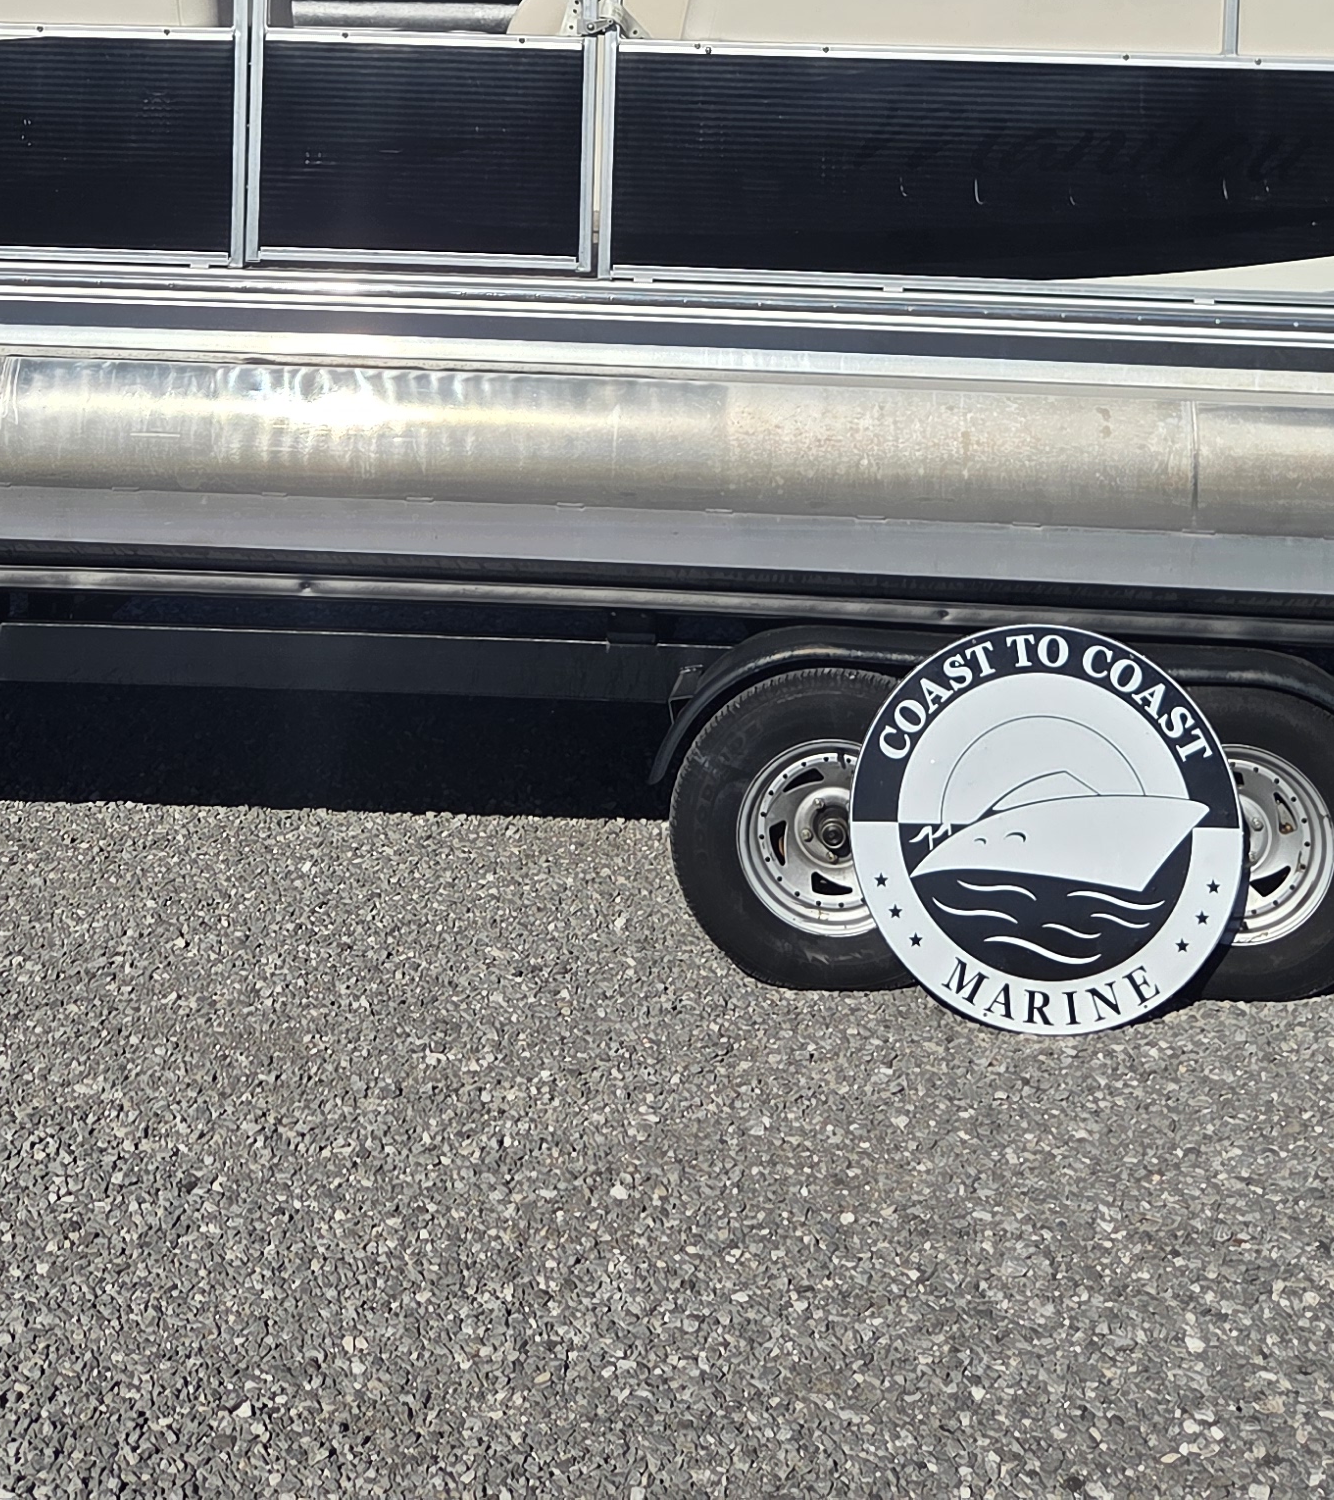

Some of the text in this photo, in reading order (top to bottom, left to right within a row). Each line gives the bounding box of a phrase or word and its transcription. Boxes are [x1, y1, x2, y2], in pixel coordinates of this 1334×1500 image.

[878, 633, 1213, 763] COAST TO COAST
[941, 956, 1161, 1027] MARINE
